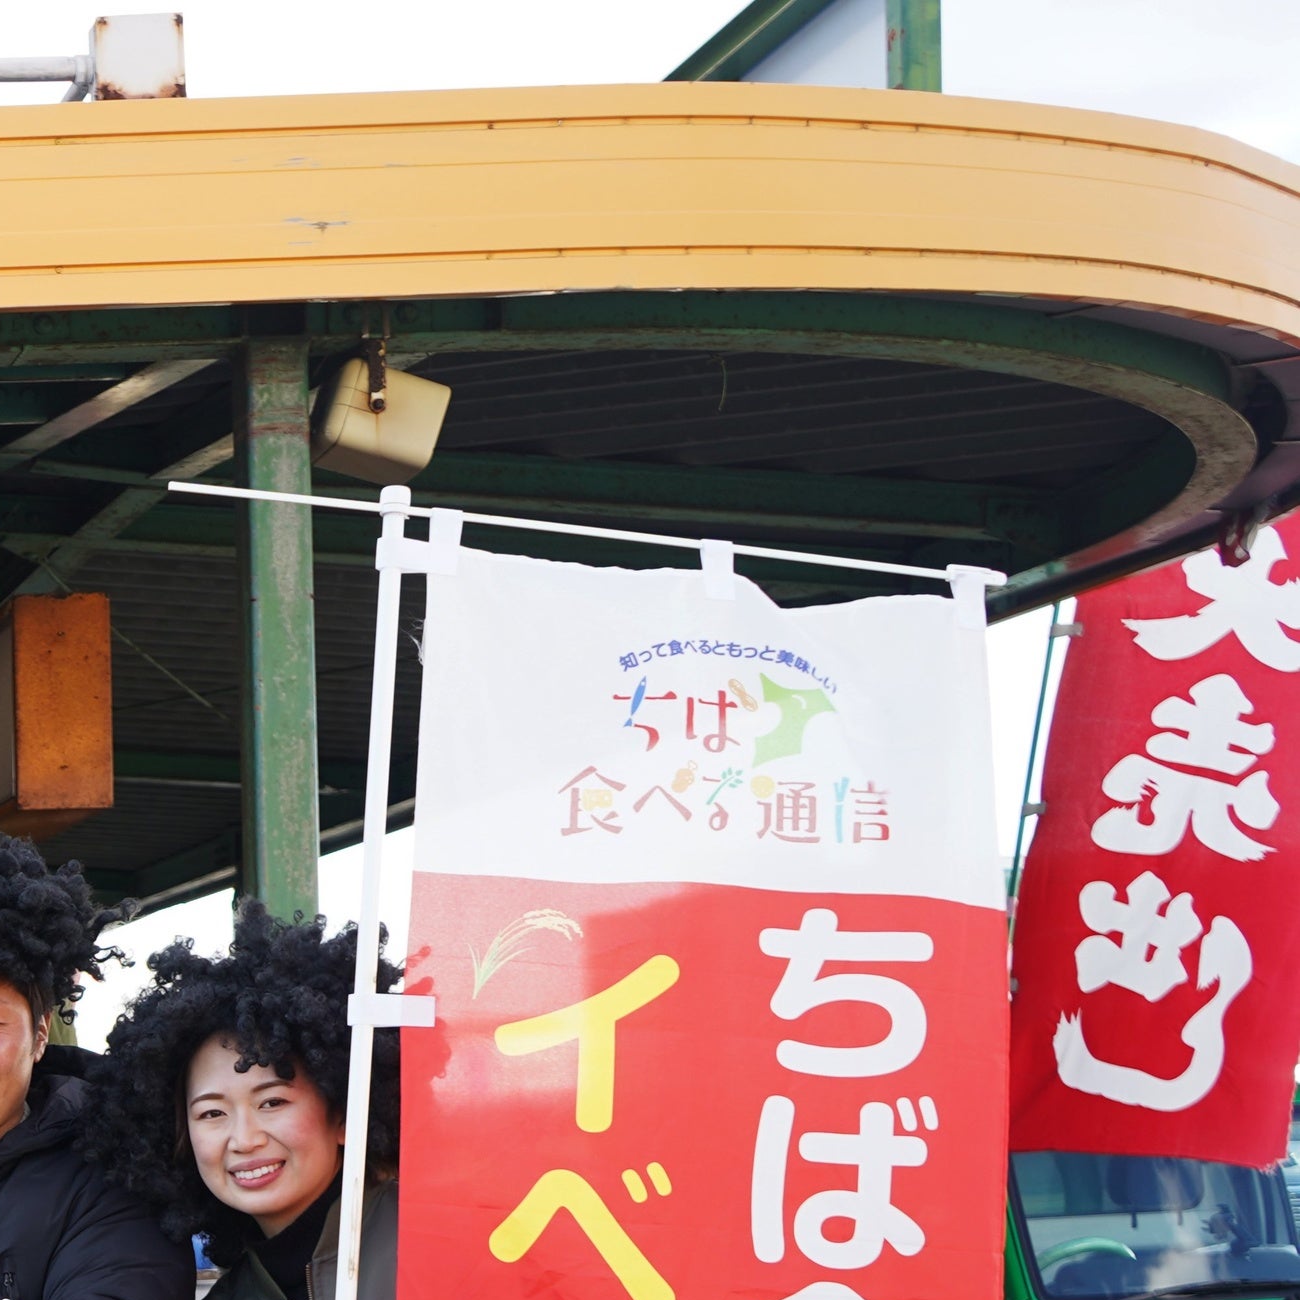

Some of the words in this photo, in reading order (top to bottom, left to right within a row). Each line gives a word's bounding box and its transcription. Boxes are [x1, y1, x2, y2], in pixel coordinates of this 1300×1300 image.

[619, 640, 837, 695] 知って食べるともっと美味しい
[558, 760, 891, 844] 食べる通信
